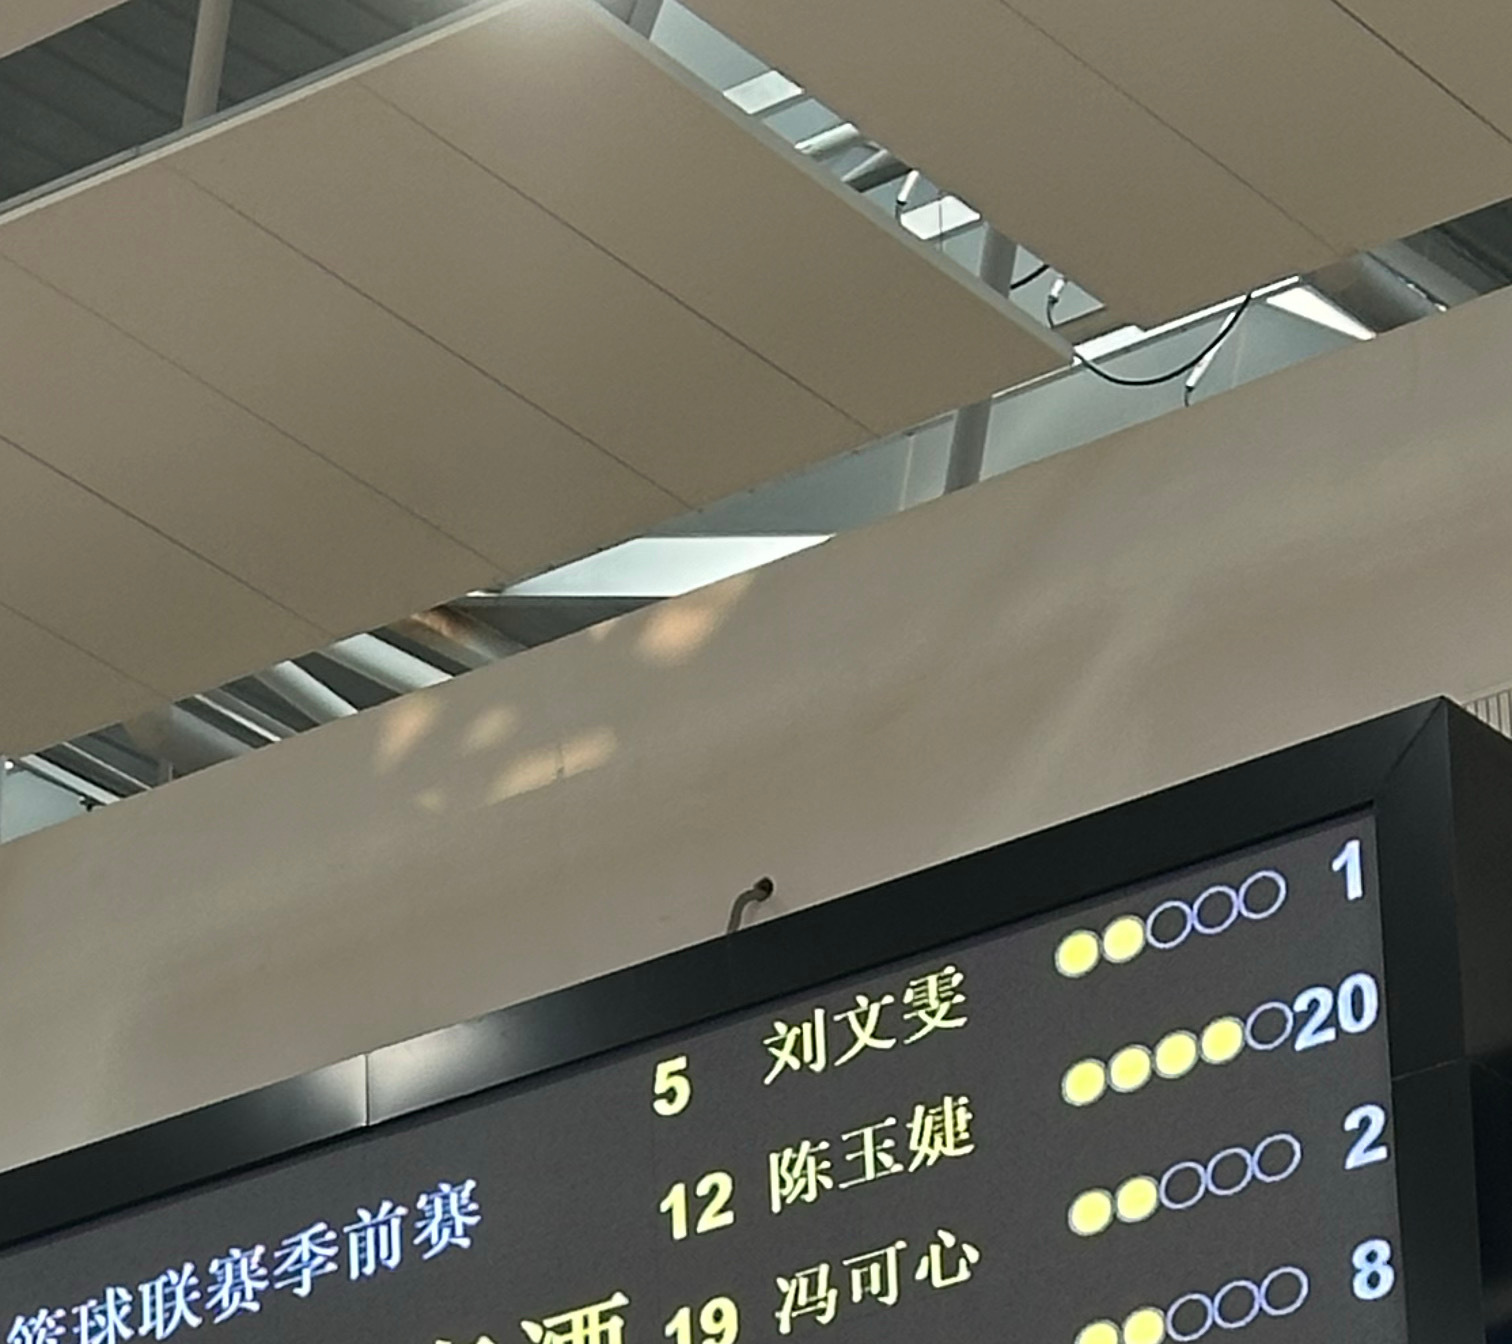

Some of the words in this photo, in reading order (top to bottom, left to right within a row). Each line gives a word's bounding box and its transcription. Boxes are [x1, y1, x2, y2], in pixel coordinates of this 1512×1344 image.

[652, 1055, 691, 1116] 5
[763, 965, 968, 1085] 刘文雯
[1331, 839, 1363, 901] 1
[659, 1171, 734, 1241] 12
[769, 1095, 975, 1214] 陈玉婕
[1292, 972, 1379, 1052] 20
[774, 1229, 980, 1335] 冯可心
[1343, 1104, 1388, 1170] 2
[1351, 1238, 1395, 1301] 8
